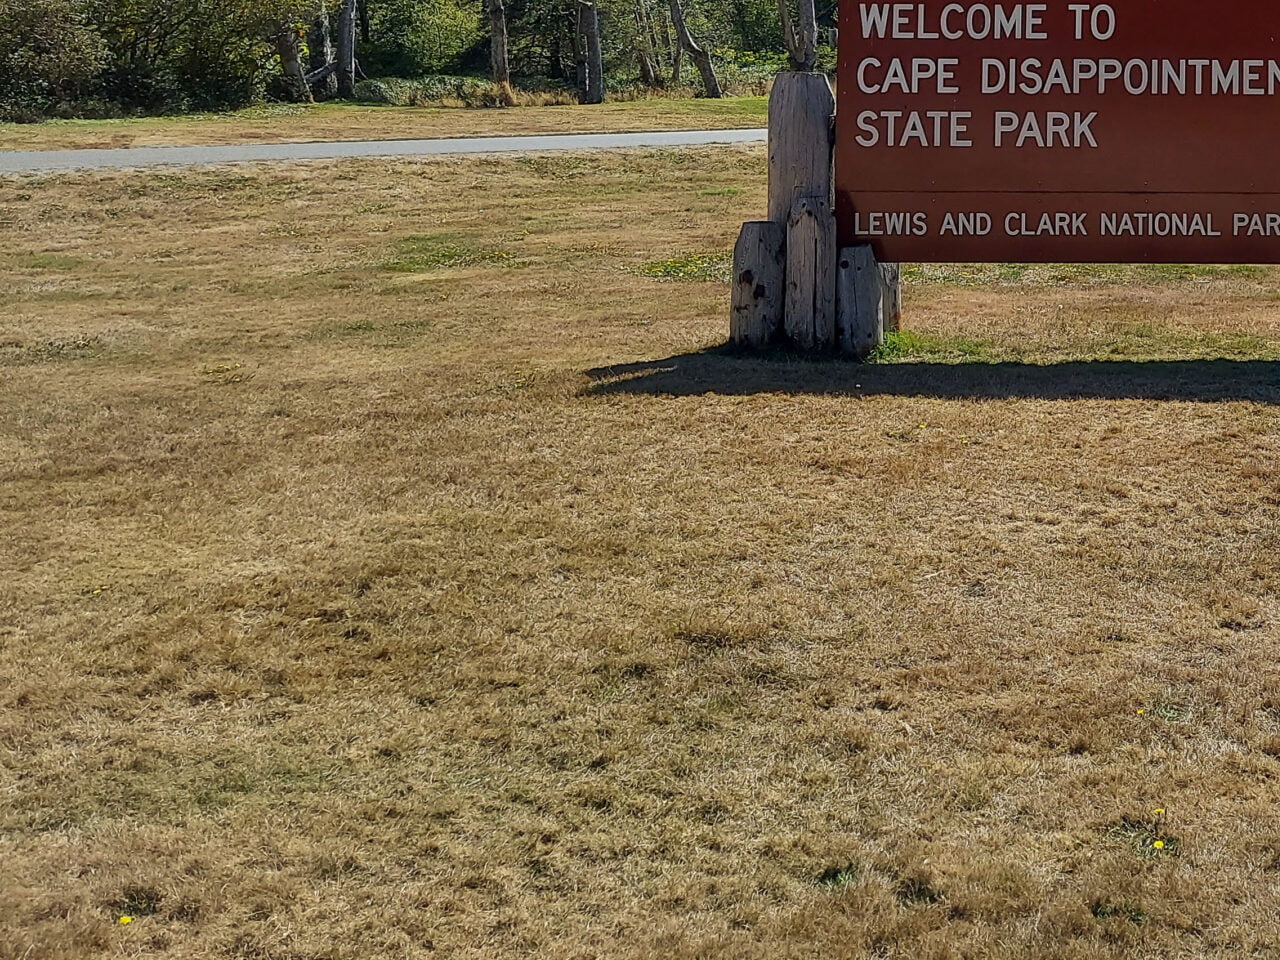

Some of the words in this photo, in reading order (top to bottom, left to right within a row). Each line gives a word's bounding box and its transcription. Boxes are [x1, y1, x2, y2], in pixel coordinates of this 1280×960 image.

[859, 3, 1048, 40] WELCOME
[1068, 4, 1116, 40] TO
[857, 57, 959, 94] CAPE
[855, 110, 972, 147] STATE
[994, 111, 1098, 148] PARK
[854, 212, 927, 236] LEWIS
[939, 212, 992, 236] AND
[1004, 212, 1087, 236] CLARK
[1100, 212, 1221, 236] NATIONAL
